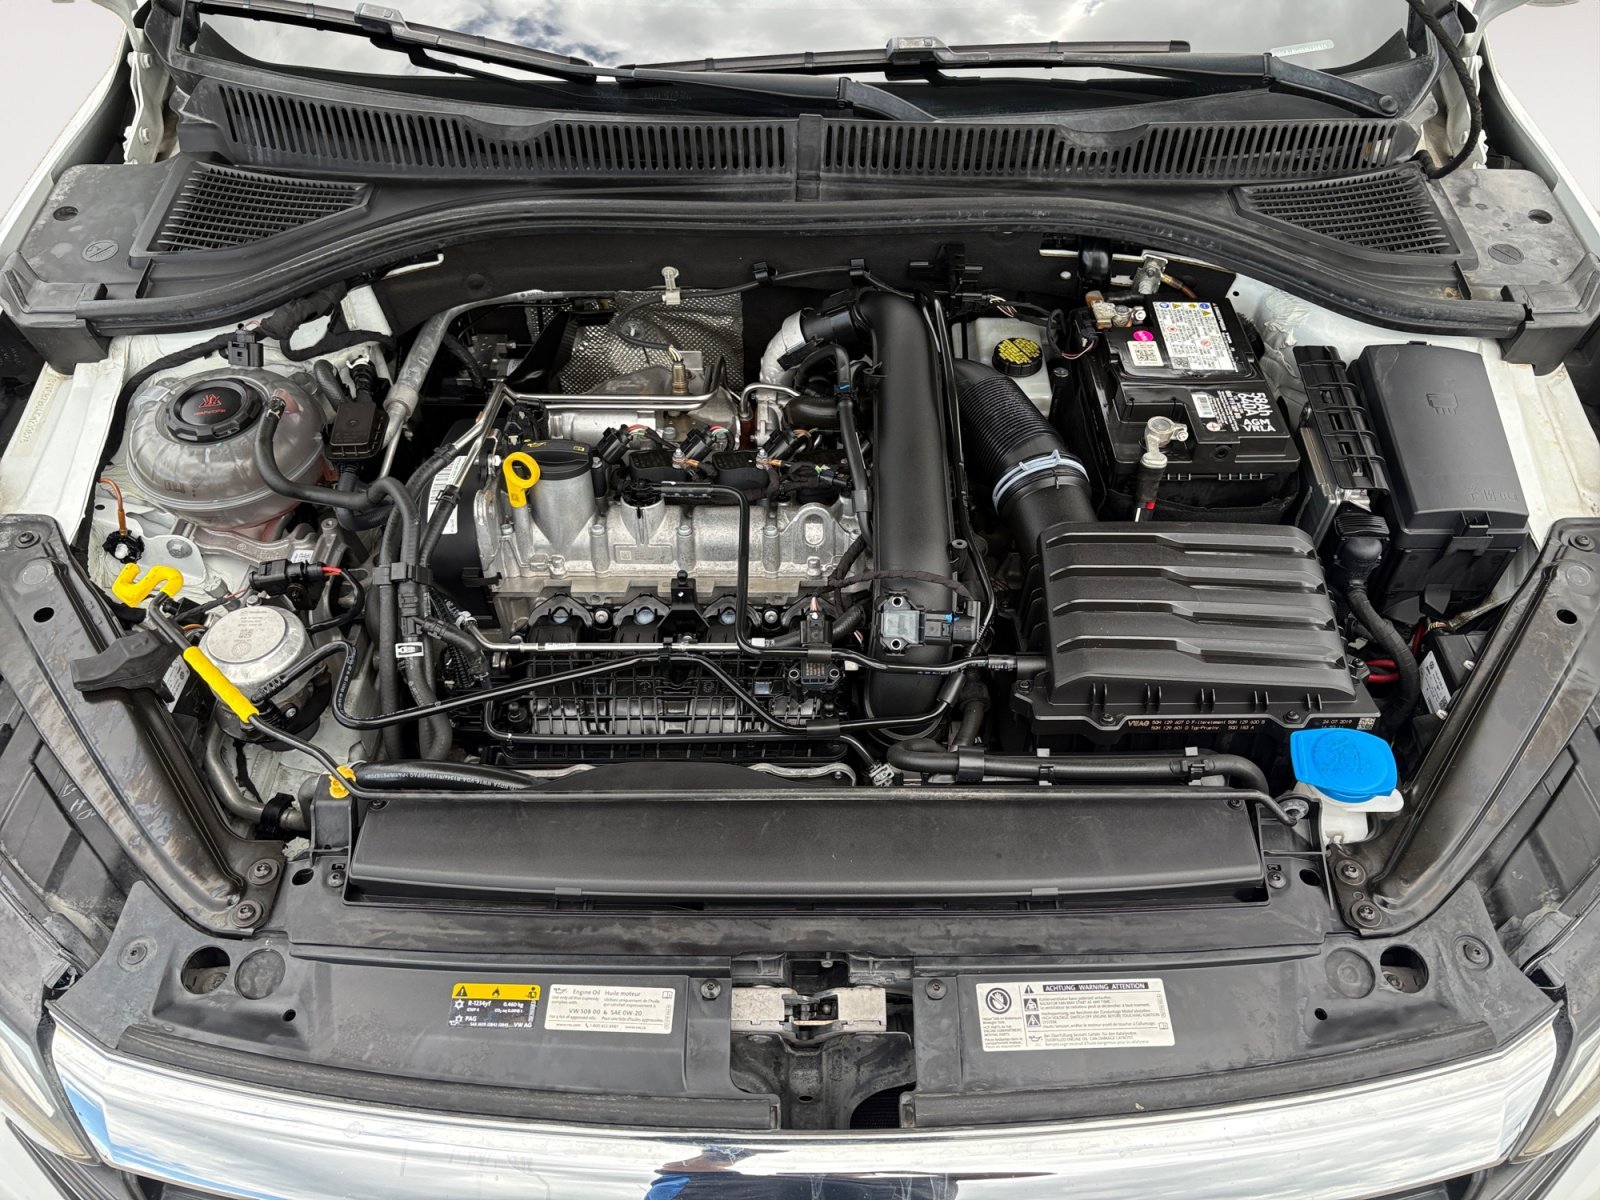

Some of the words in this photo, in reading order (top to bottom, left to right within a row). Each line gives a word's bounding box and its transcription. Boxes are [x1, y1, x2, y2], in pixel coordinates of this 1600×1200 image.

[1238, 393, 1259, 416] 640A
[1252, 392, 1273, 416] 58Ah
[468, 1000, 492, 1008] R-1234yf
